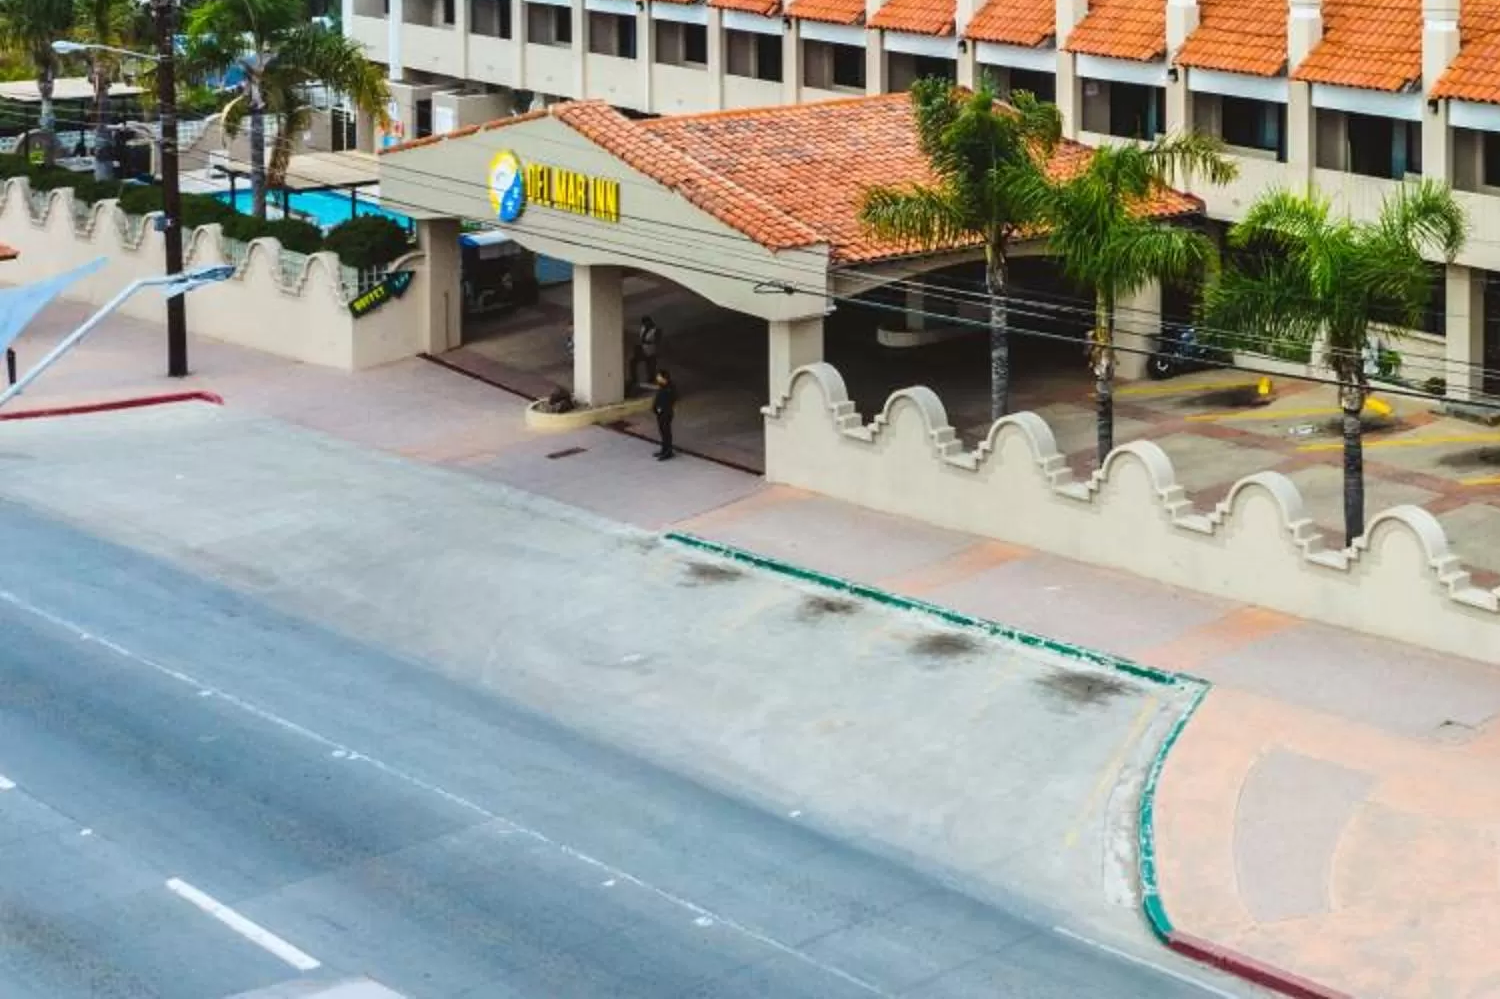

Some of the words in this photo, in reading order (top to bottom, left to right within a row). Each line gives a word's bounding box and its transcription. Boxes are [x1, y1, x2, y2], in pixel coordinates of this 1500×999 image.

[526, 163, 551, 207] DEL
[554, 168, 587, 216] MAR
[588, 175, 619, 223] INN
